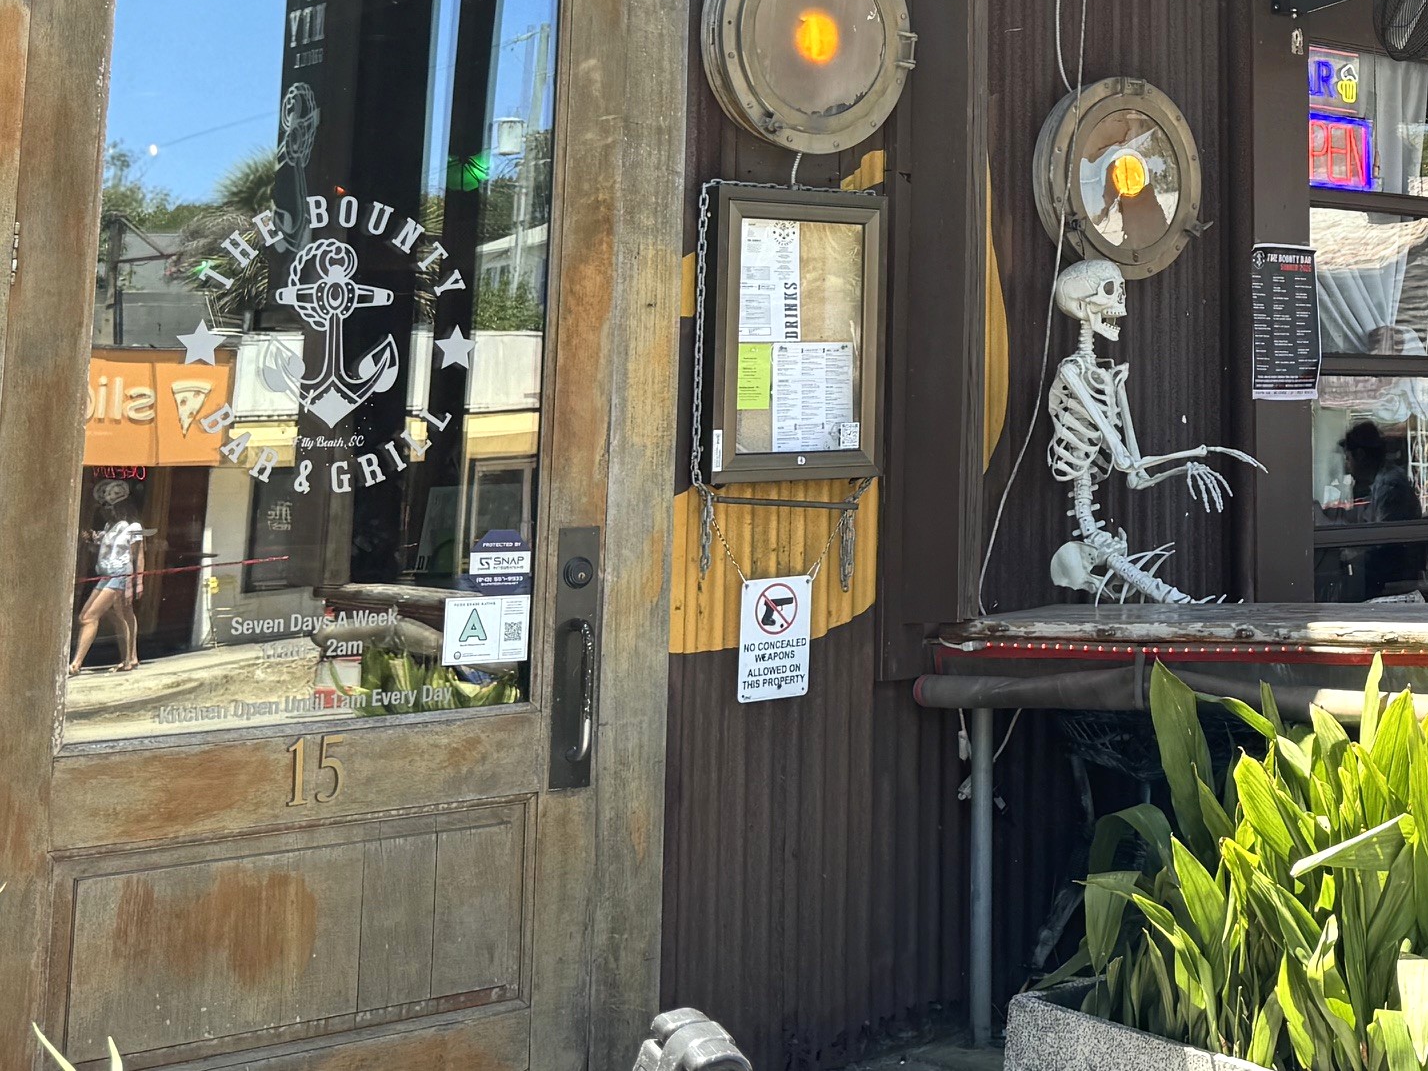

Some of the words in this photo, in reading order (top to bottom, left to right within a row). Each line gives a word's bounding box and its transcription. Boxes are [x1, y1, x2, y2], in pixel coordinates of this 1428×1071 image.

[1309, 60, 1336, 98] R
[1309, 120, 1367, 186] PEN
[199, 209, 284, 289] THE
[306, 195, 466, 297] BOUNTY
[784, 281, 799, 340] DRINKS
[200, 402, 280, 483] BAR
[294, 459, 313, 494] &
[331, 408, 452, 494] GRILL
[292, 435, 314, 450] Flly
[348, 435, 365, 447] SC
[493, 555, 525, 566] SNAP
[231, 613, 285, 636] Seven
[289, 612, 333, 634] Days
[335, 611, 349, 628] A
[352, 606, 399, 629] Week
[458, 607, 488, 642] A
[326, 638, 364, 657] 2am
[743, 643, 756, 653] NO
[757, 637, 807, 652] CONCEALED
[755, 650, 795, 663] WEAPONS
[742, 680, 760, 690] THIS
[762, 674, 805, 688] PROPERTY
[747, 664, 787, 678] ALLOWED
[789, 663, 801, 674] ON
[331, 692, 367, 709] 1am
[371, 686, 418, 708] Every
[422, 684, 453, 704] Day
[286, 734, 345, 809] 15
